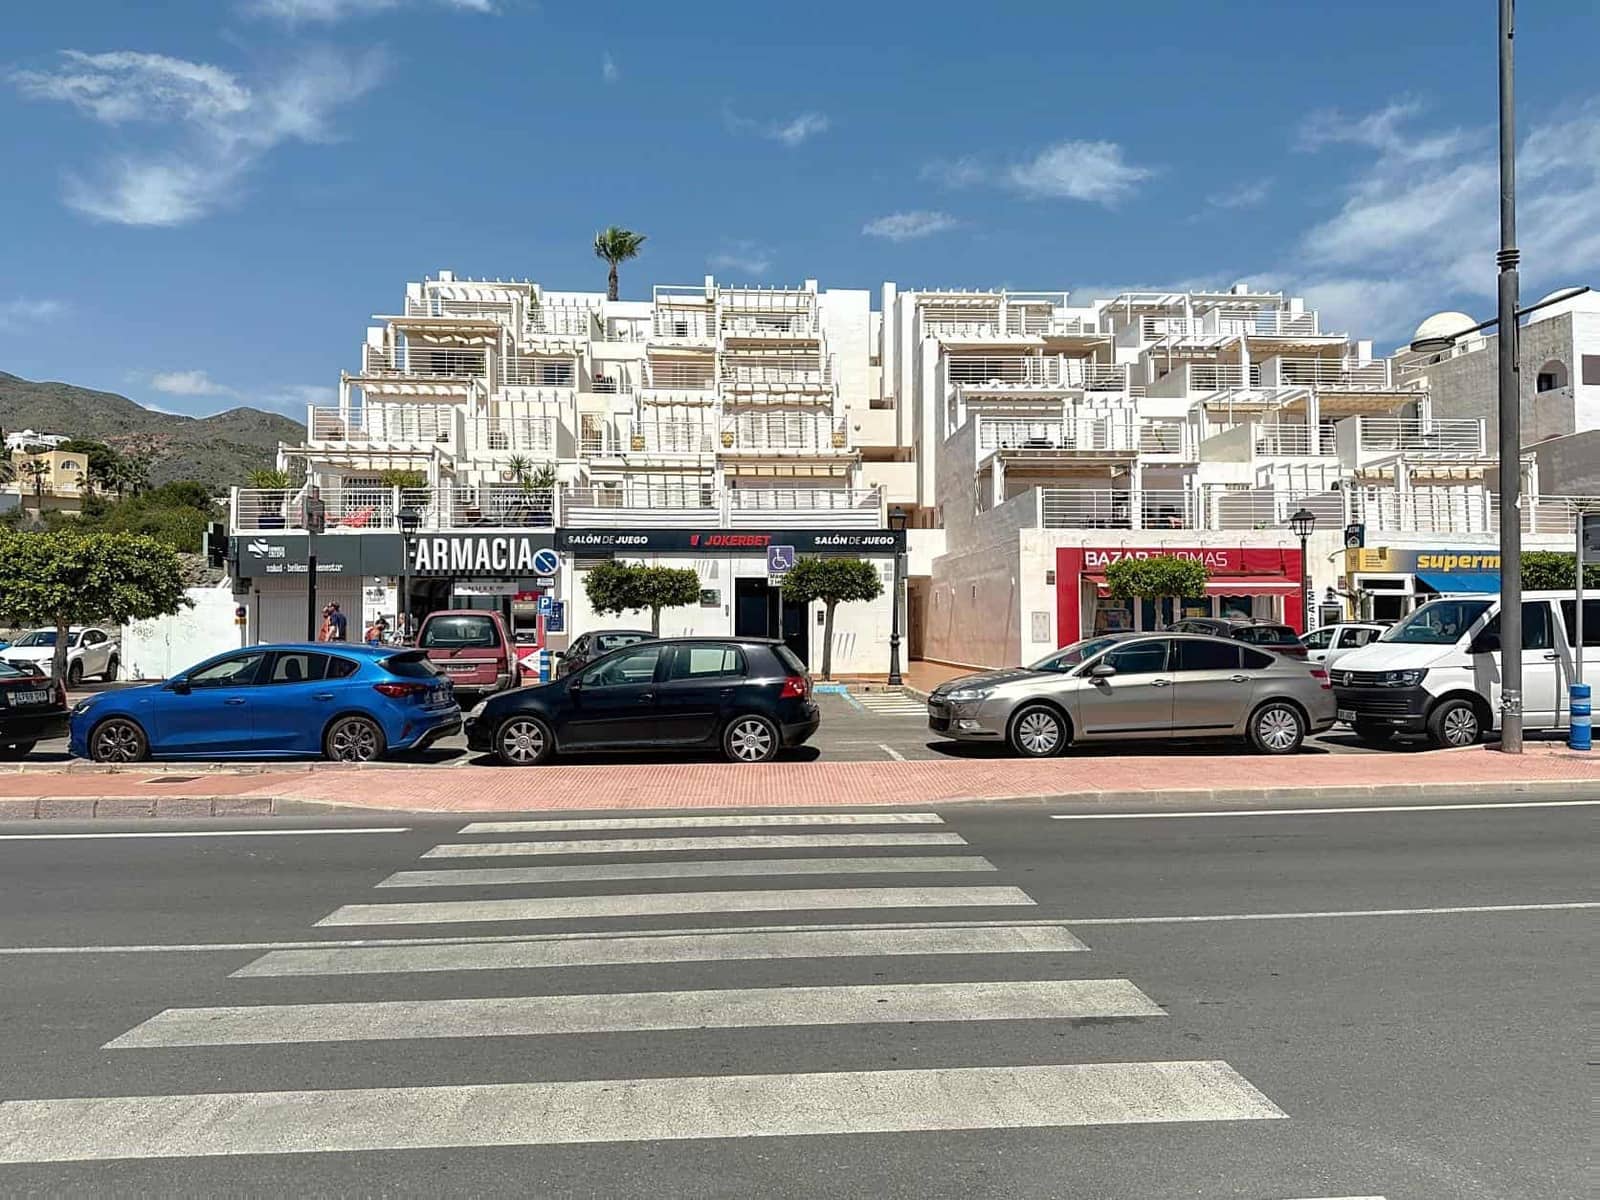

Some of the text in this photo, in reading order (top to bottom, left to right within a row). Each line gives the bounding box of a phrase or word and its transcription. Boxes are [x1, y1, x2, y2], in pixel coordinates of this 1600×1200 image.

[568, 533, 648, 544] SALÓN DE JUEGO
[704, 535, 771, 546] JOKERBET
[814, 534, 894, 545] SALÓN DE JUEGO
[1085, 551, 1228, 567] BAZAR TOMAS
[541, 597, 550, 609] P
